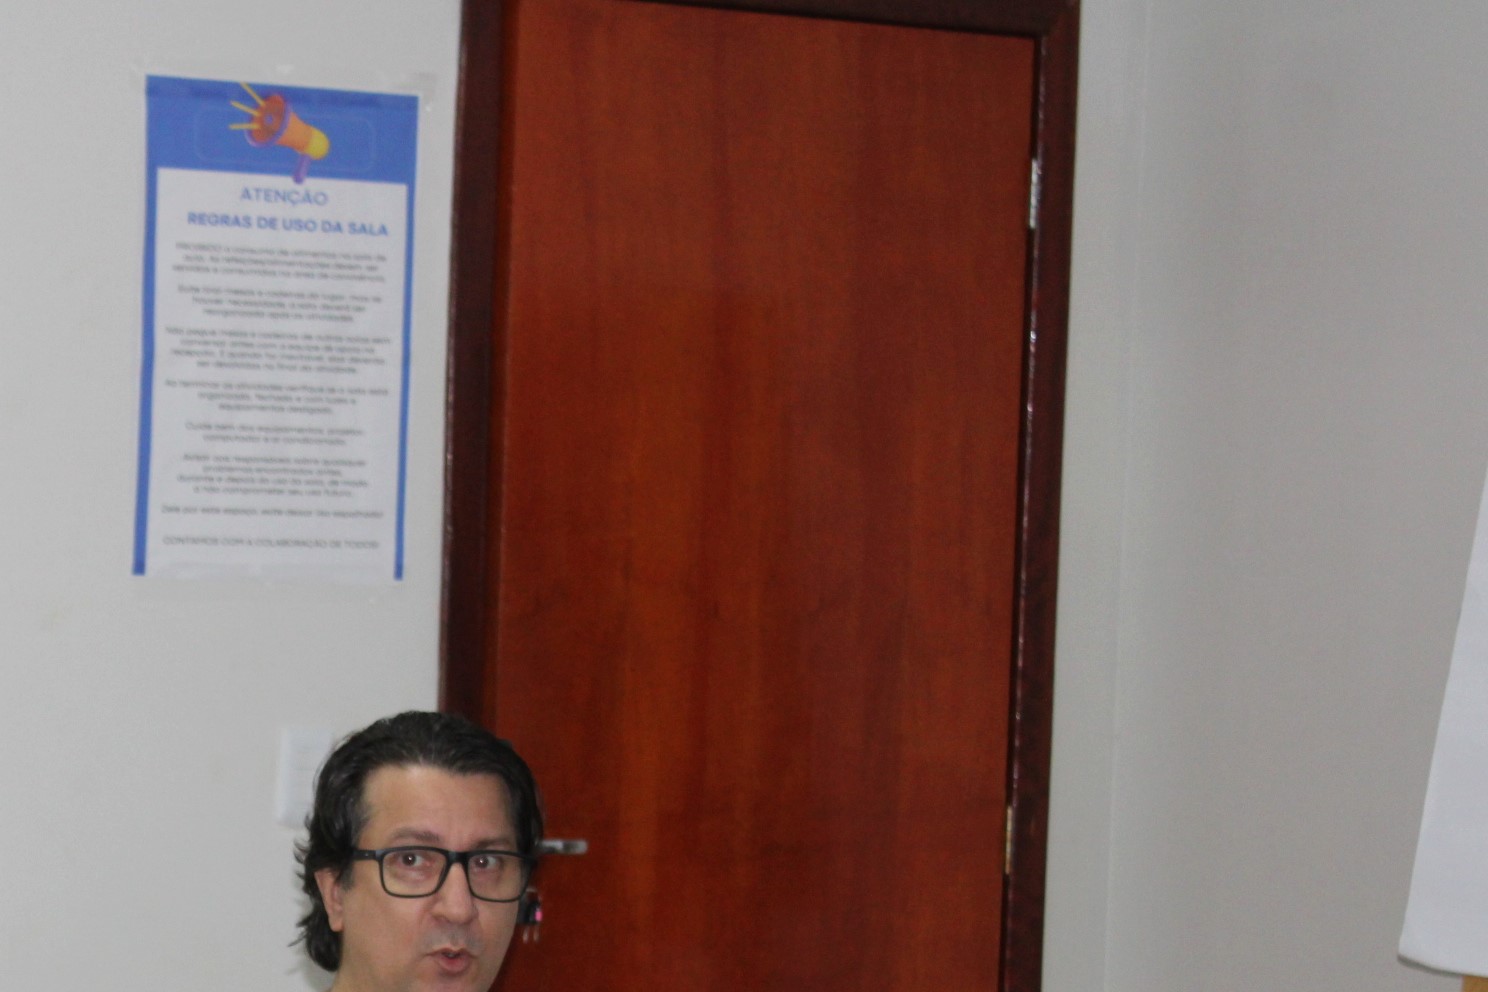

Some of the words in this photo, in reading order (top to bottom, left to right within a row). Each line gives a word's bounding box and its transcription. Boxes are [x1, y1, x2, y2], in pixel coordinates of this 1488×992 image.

[240, 186, 328, 207] ATENÇÃO
[187, 211, 252, 229] REGRAS
[256, 215, 278, 231] DE
[282, 217, 318, 233] USO
[321, 220, 344, 234] DA
[348, 221, 389, 237] SALA
